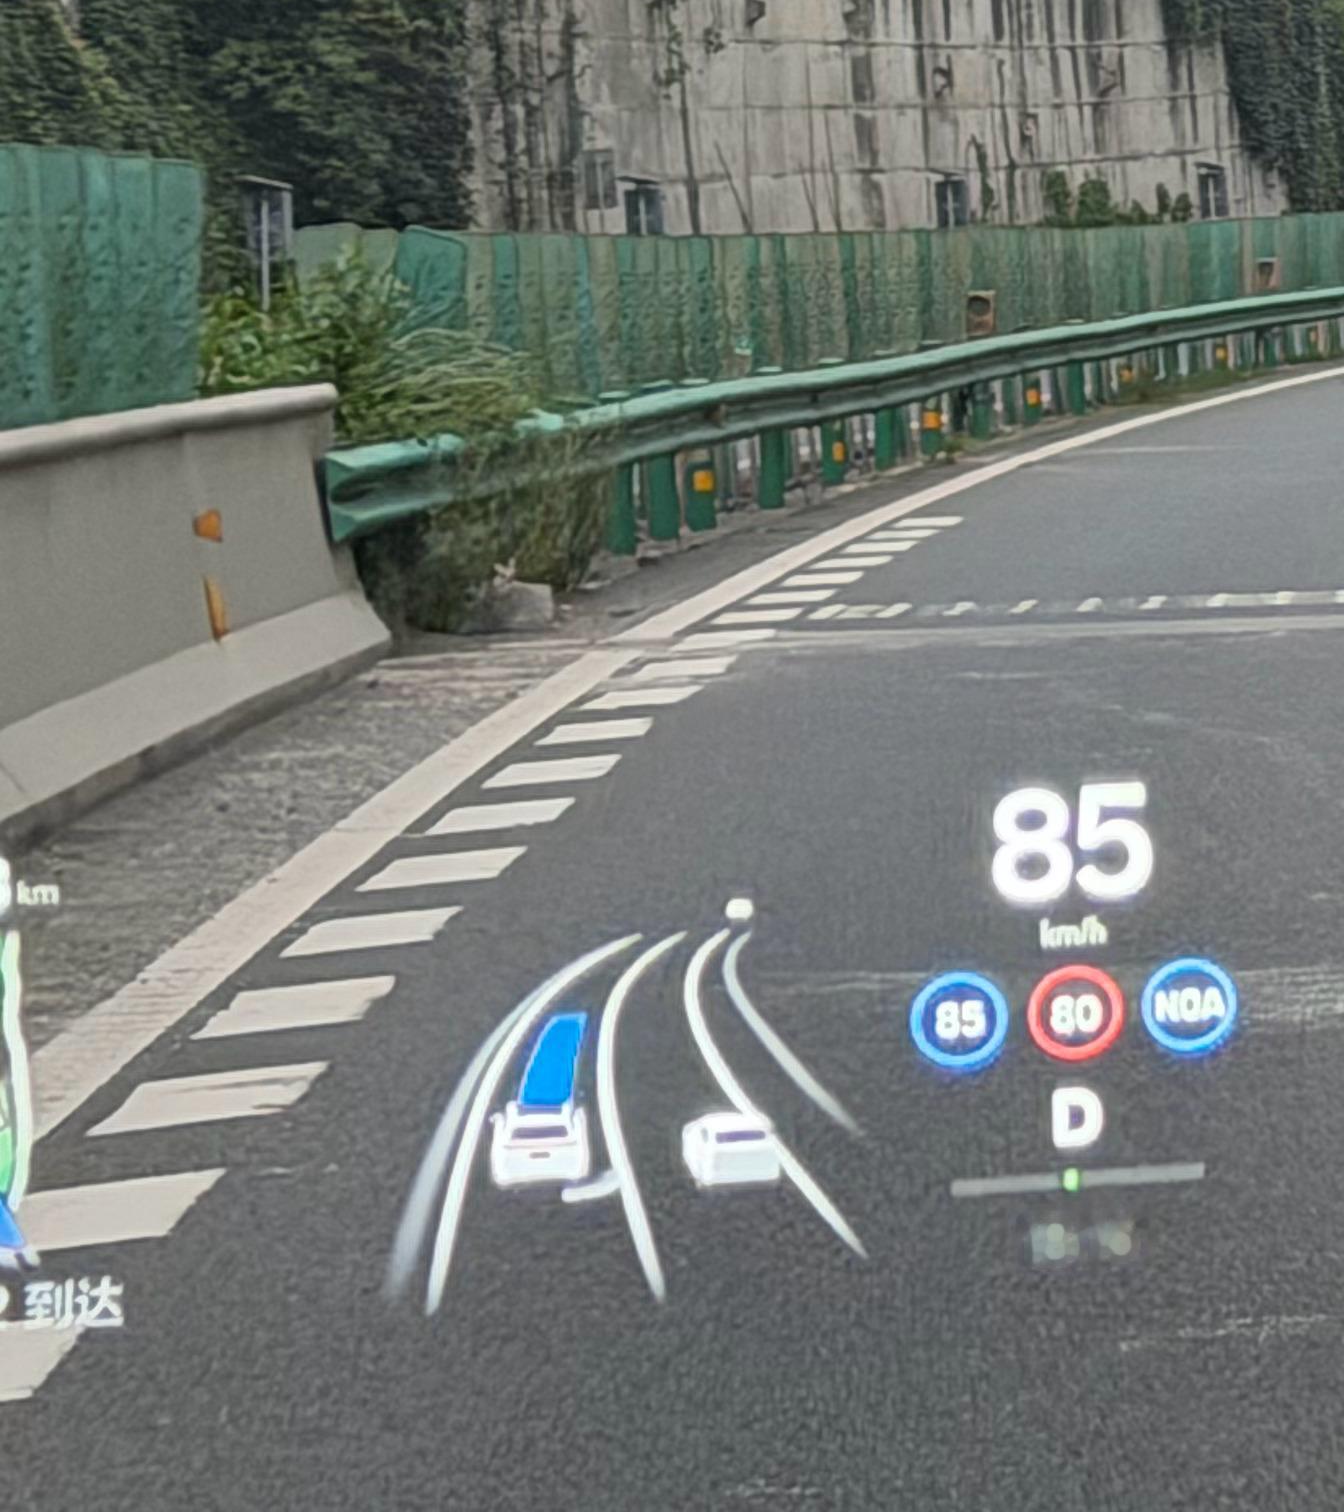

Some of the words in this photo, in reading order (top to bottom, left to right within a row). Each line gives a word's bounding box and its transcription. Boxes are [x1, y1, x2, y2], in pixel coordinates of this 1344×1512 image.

[992, 782, 1154, 902] 85
[16, 880, 60, 905] km
[1039, 915, 1108, 949] km/h
[935, 999, 987, 1039] 85
[1049, 993, 1103, 1036] 80
[1154, 986, 1226, 1023] NOA
[1051, 1087, 1104, 1149] D
[23, 1275, 125, 1330] 到达
